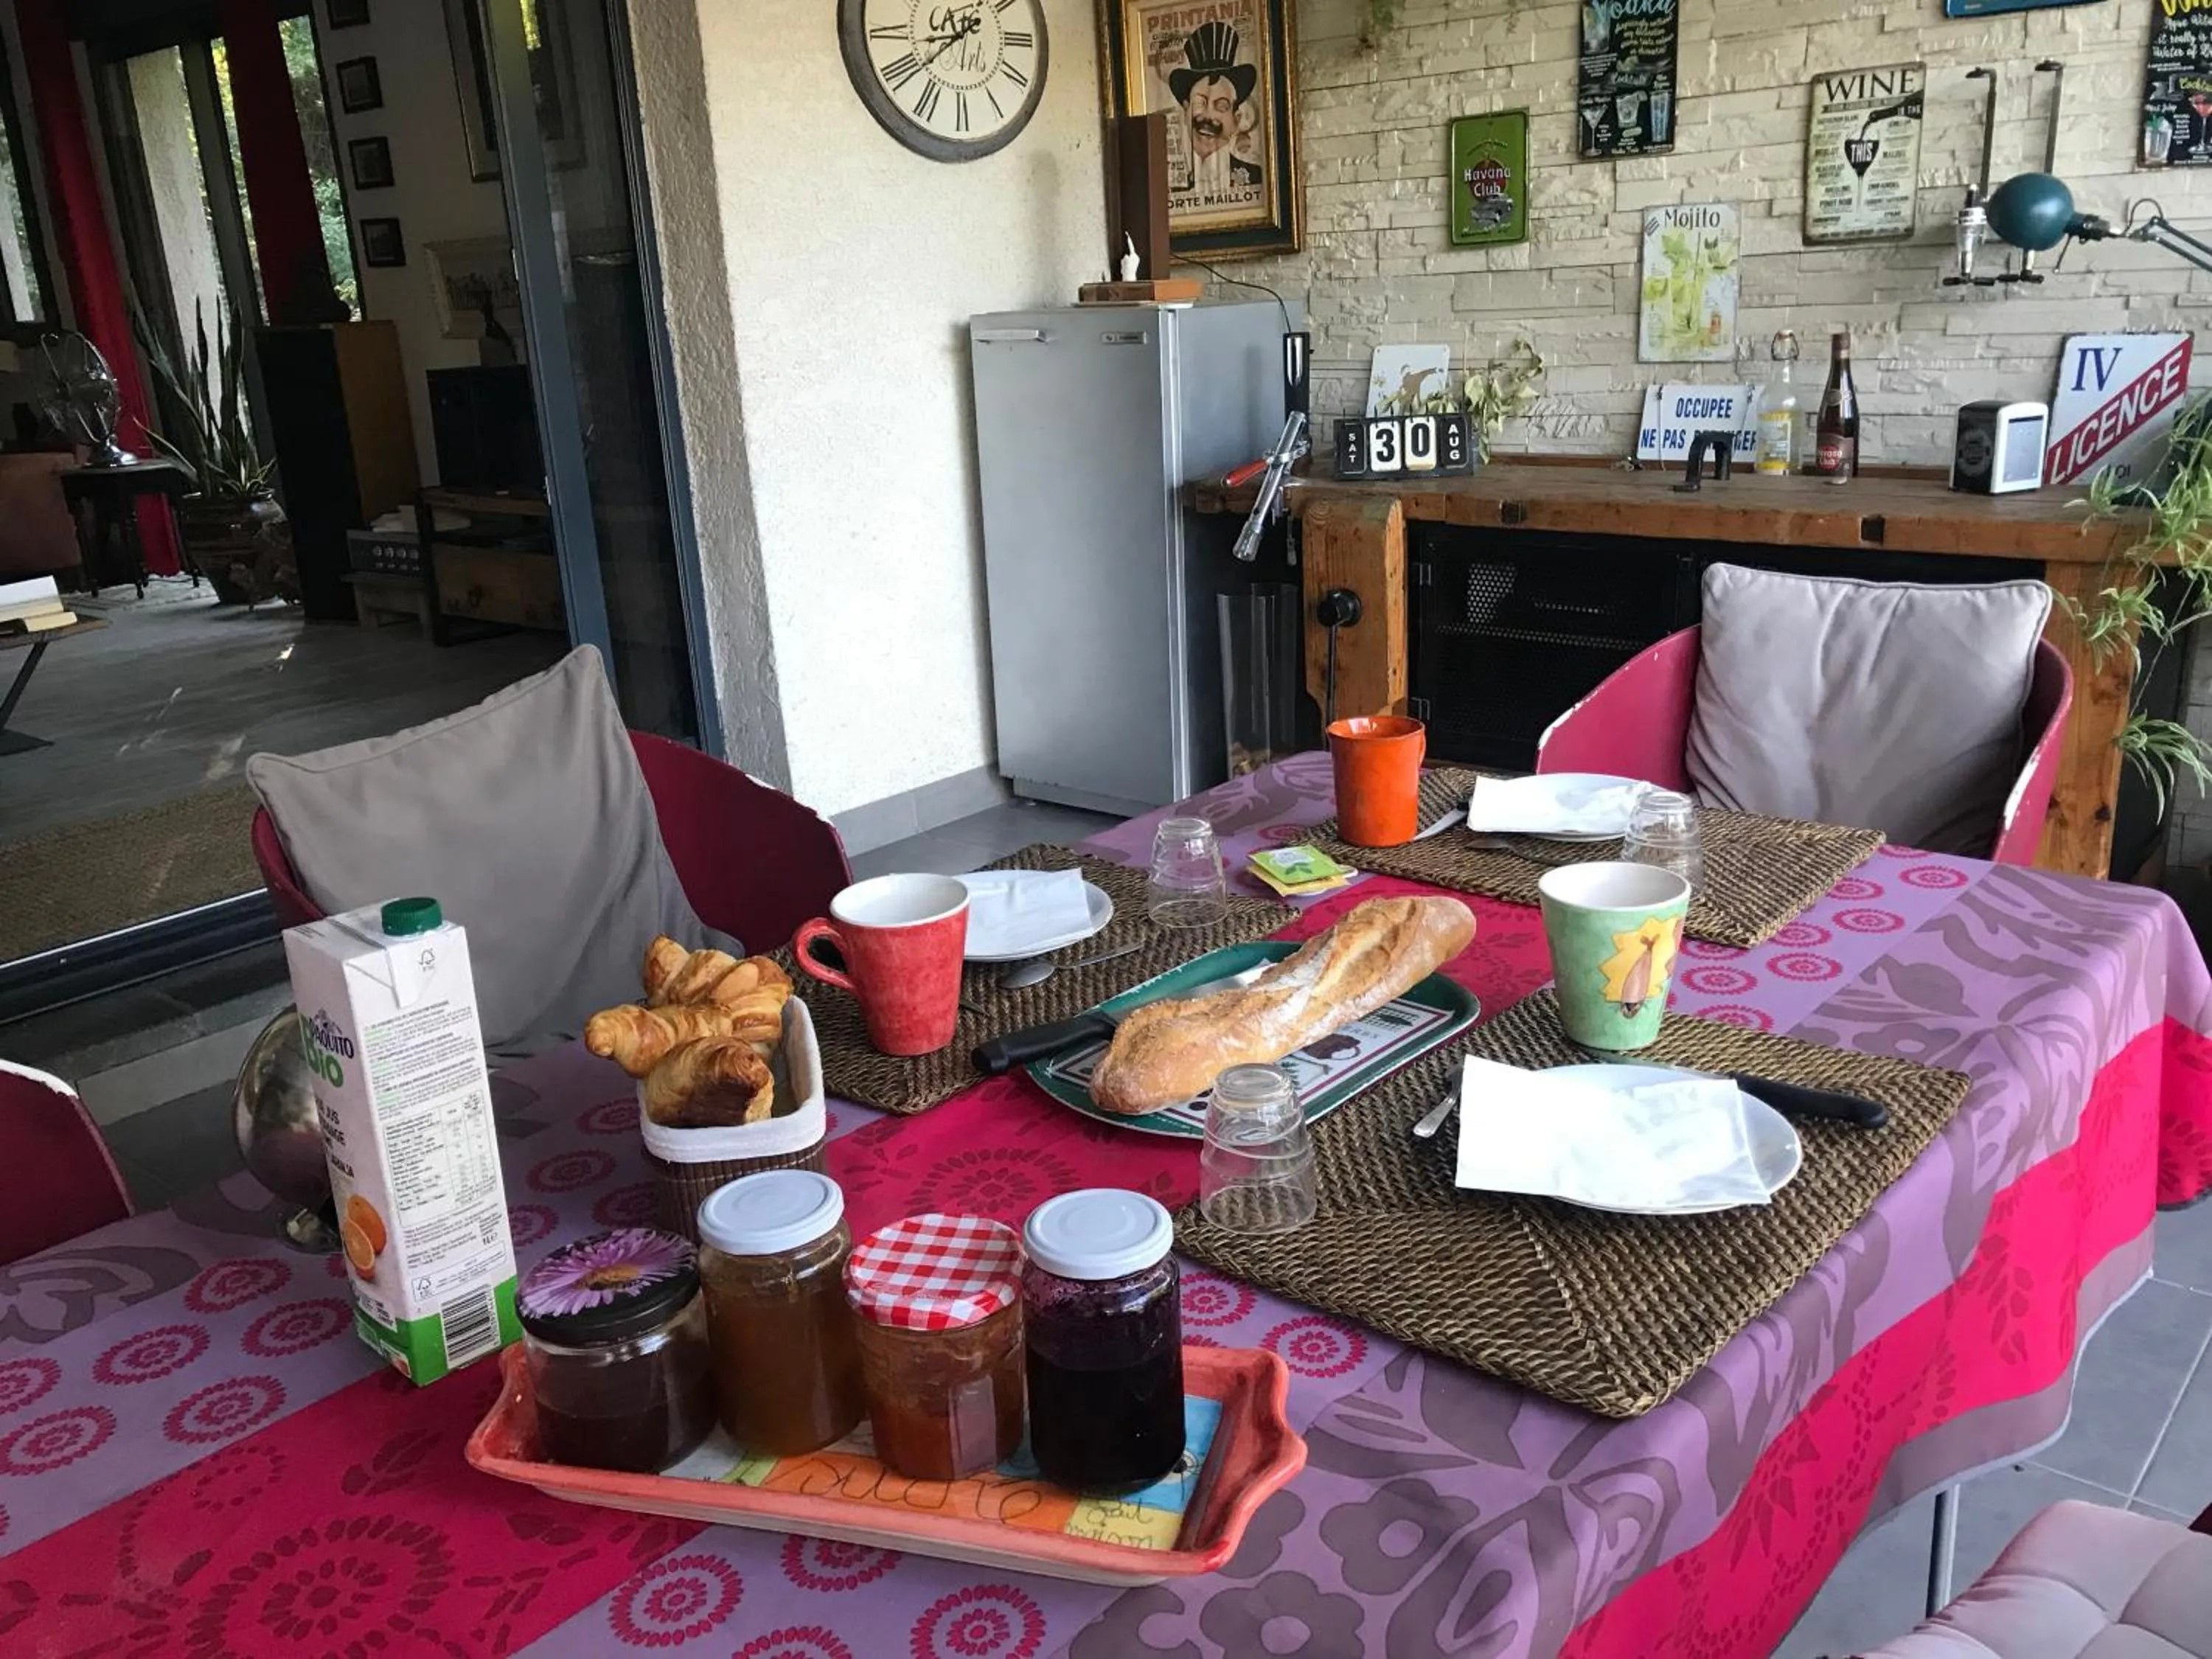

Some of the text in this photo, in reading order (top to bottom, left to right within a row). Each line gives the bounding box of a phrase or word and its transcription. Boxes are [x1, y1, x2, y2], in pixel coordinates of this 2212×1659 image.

[1825, 68, 1916, 102] WINE
[1851, 142, 1874, 164] THIS
[1463, 167, 1511, 184] Havana
[1167, 190, 1262, 209] ORTE MAILLOT
[1474, 181, 1501, 198] Club
[1664, 207, 1721, 230] Mojito
[2071, 347, 2123, 392] IV
[2051, 348, 2183, 484] LICENCE
[1448, 424, 1460, 460] AUG
[1641, 428, 1657, 449] NE
[1662, 428, 1687, 449] PAS
